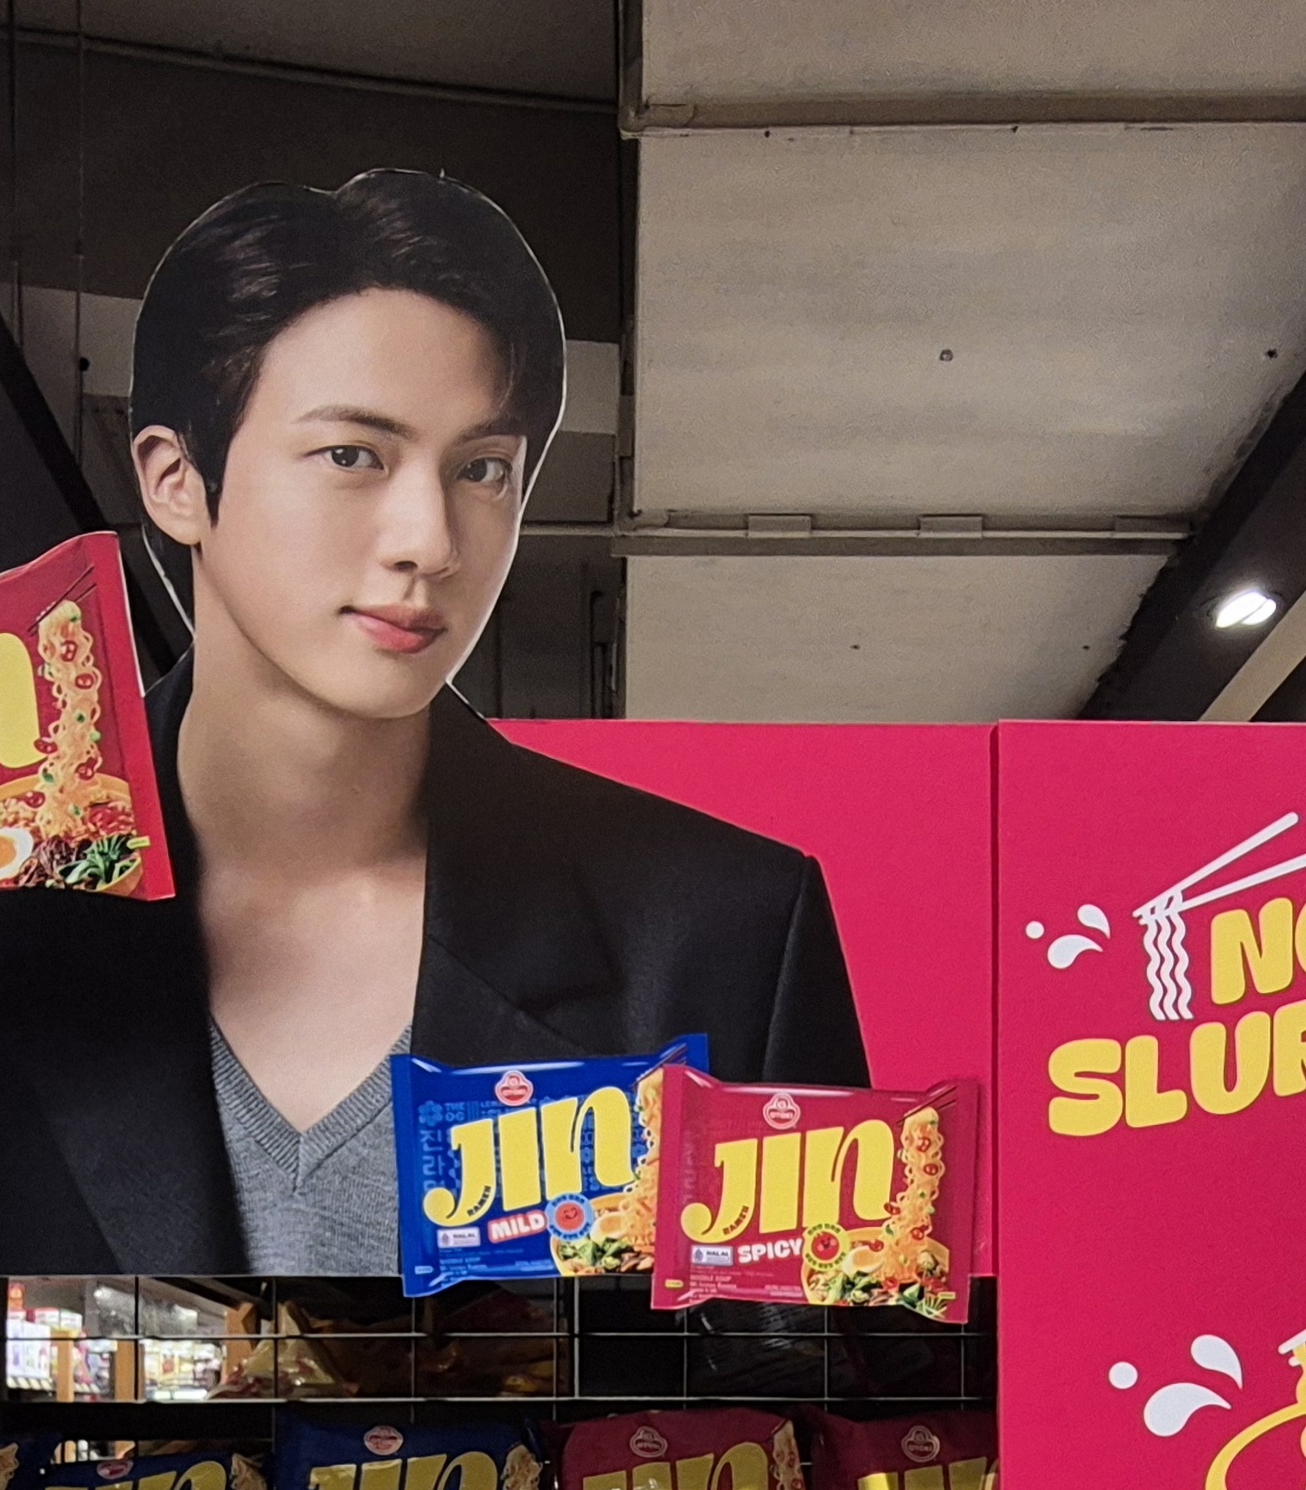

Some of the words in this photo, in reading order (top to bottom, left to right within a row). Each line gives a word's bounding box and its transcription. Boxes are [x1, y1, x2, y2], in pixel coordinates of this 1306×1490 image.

[467, 1185, 492, 1218] RAMEN
[490, 1212, 546, 1241] MILD
[722, 1205, 750, 1236] RAMEN
[737, 1238, 803, 1264] SPICY
